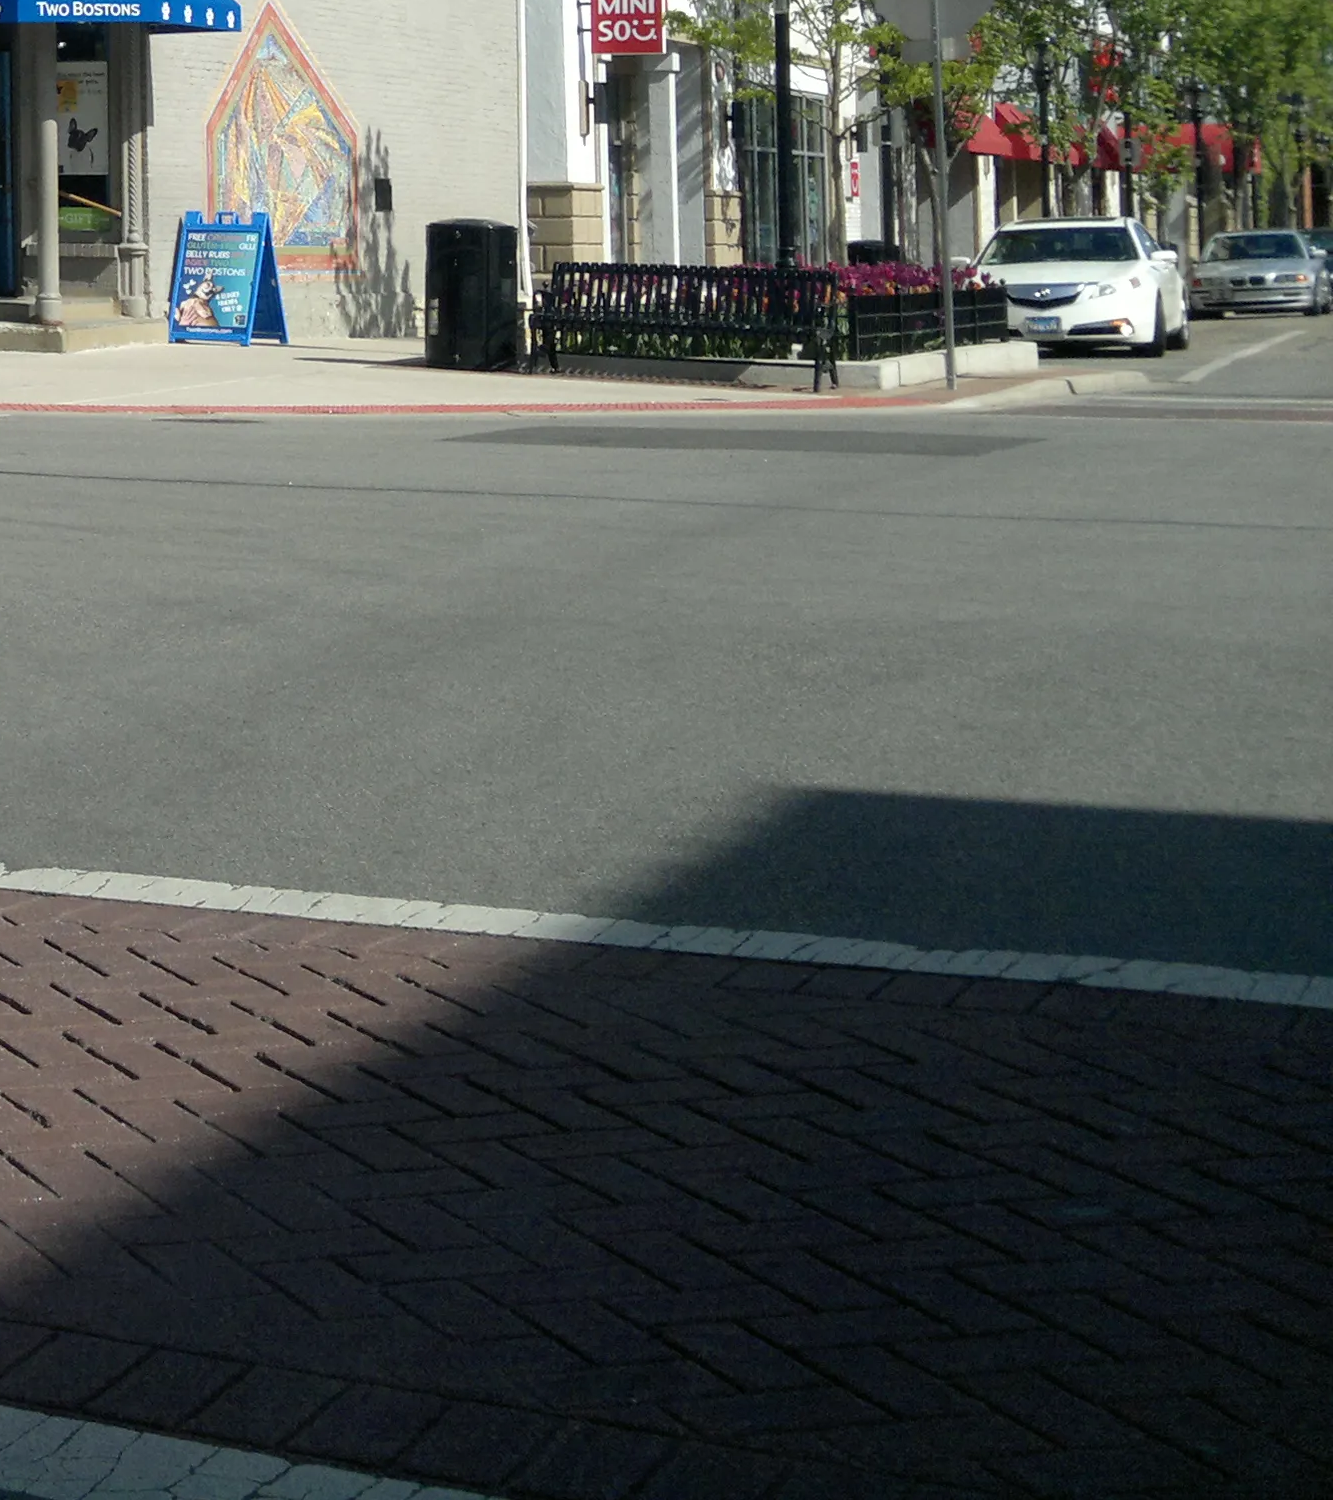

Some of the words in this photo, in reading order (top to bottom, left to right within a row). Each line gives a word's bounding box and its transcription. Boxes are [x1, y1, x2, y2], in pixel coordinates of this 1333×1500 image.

[36, 1, 70, 17] TWO
[73, 0, 141, 17] BOSTONS
[189, 233, 206, 242] FREE
[185, 250, 207, 259] BELLY
[208, 251, 231, 260] RUBS
[183, 267, 205, 276] TWO
[205, 267, 247, 277] BOSTONS
